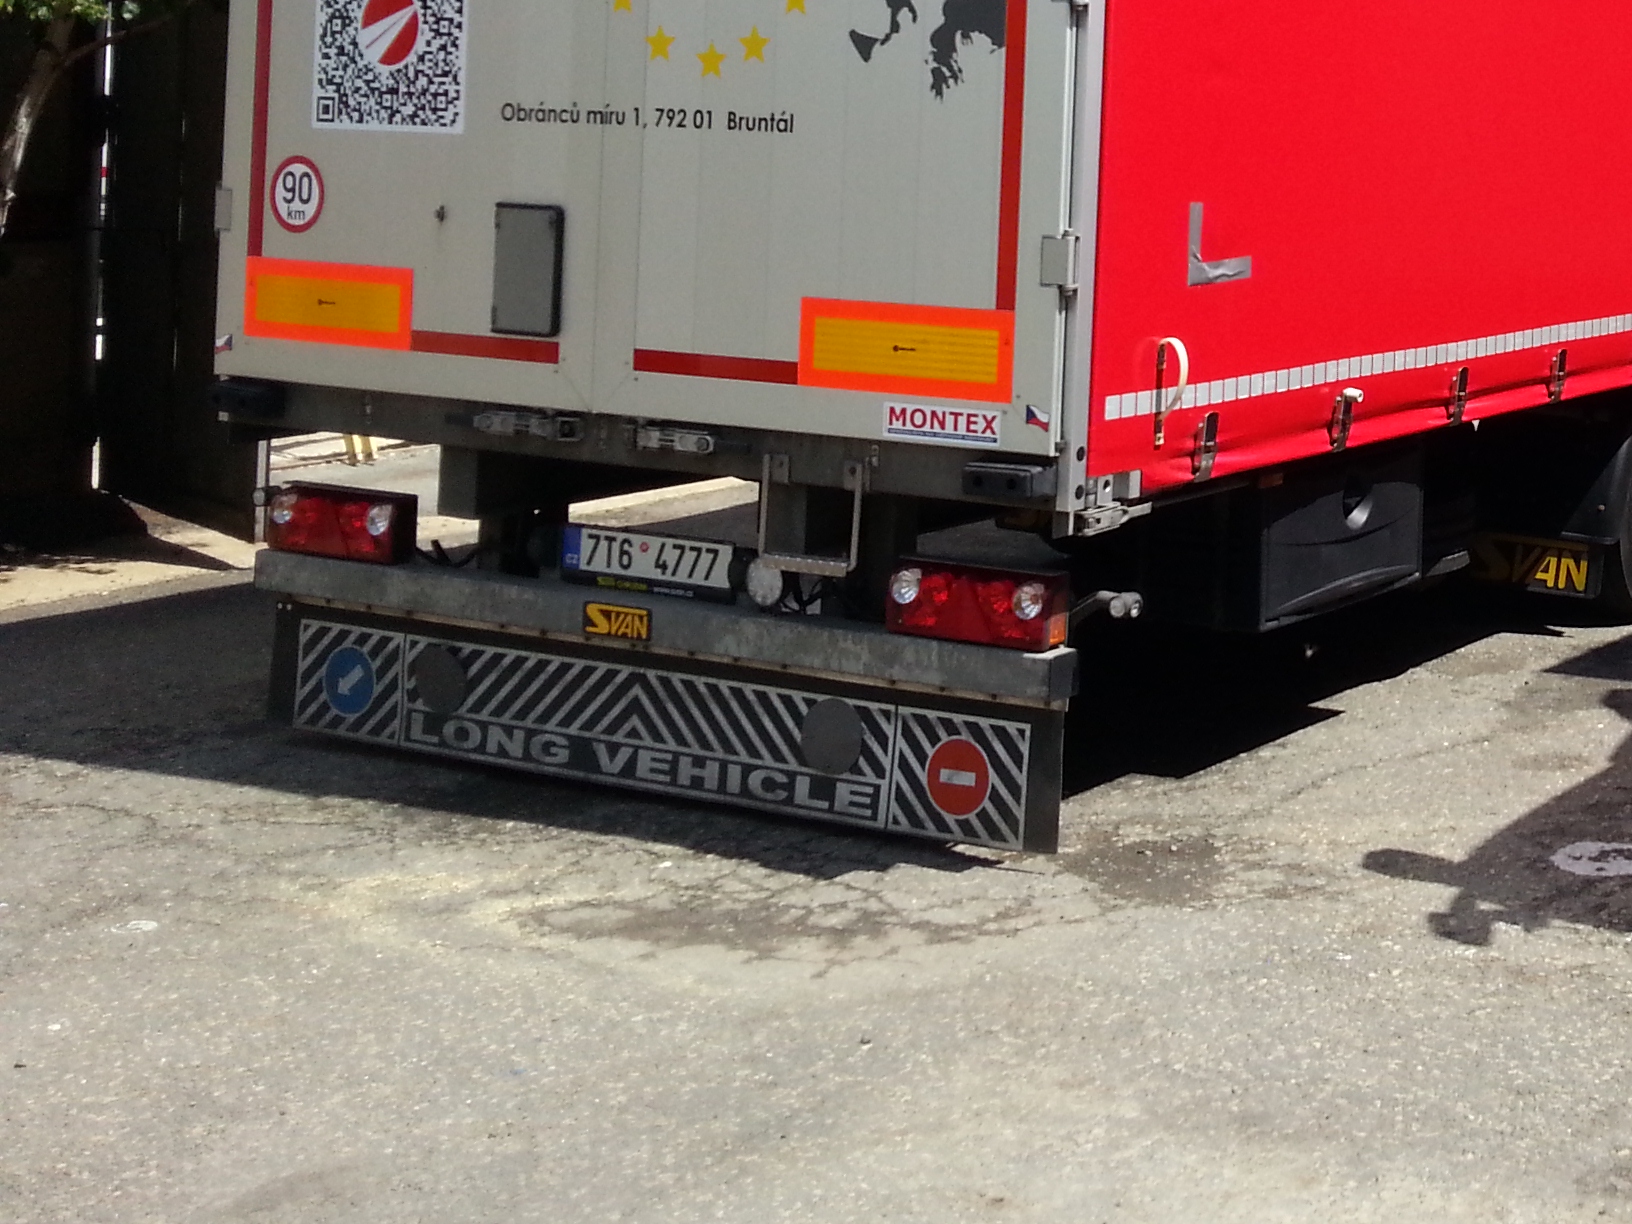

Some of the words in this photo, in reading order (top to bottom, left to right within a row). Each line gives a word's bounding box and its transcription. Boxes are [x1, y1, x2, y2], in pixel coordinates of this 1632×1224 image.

[500, 101, 582, 126] Obránců
[585, 103, 627, 127] míru
[653, 107, 688, 129] 792
[692, 108, 714, 130] 01
[726, 109, 795, 134] Bruntál
[282, 170, 313, 205] 90
[286, 205, 306, 220] km
[888, 405, 998, 436] MONTEX
[565, 552, 580, 565] CZ
[585, 533, 633, 571] 7T6
[654, 541, 720, 582] 4777
[585, 602, 650, 640] SVAN
[408, 710, 571, 766] LONG
[592, 740, 880, 820] VEHICLE
